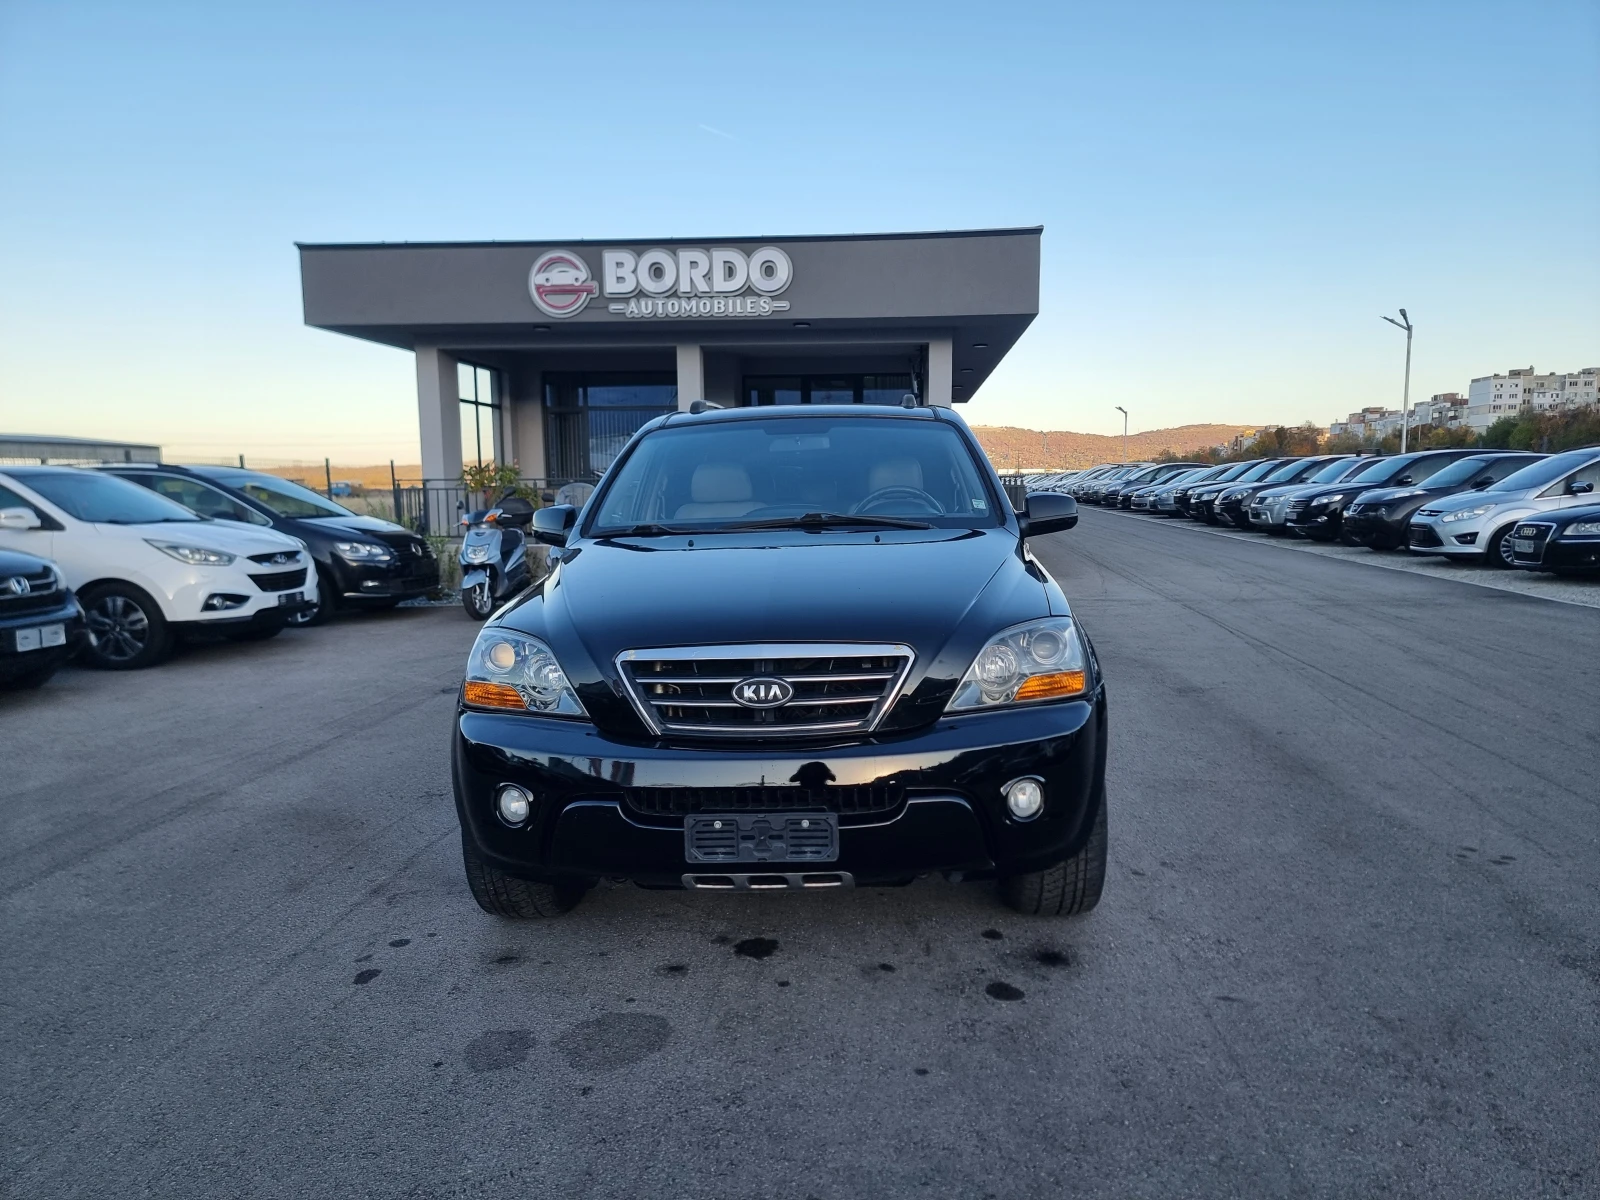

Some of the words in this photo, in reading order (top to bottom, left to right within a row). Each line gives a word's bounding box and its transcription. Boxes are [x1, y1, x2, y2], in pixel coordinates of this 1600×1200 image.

[603, 249, 789, 293] BORDO
[627, 300, 771, 315] AUTOMOBILES
[743, 685, 783, 700] KIA
